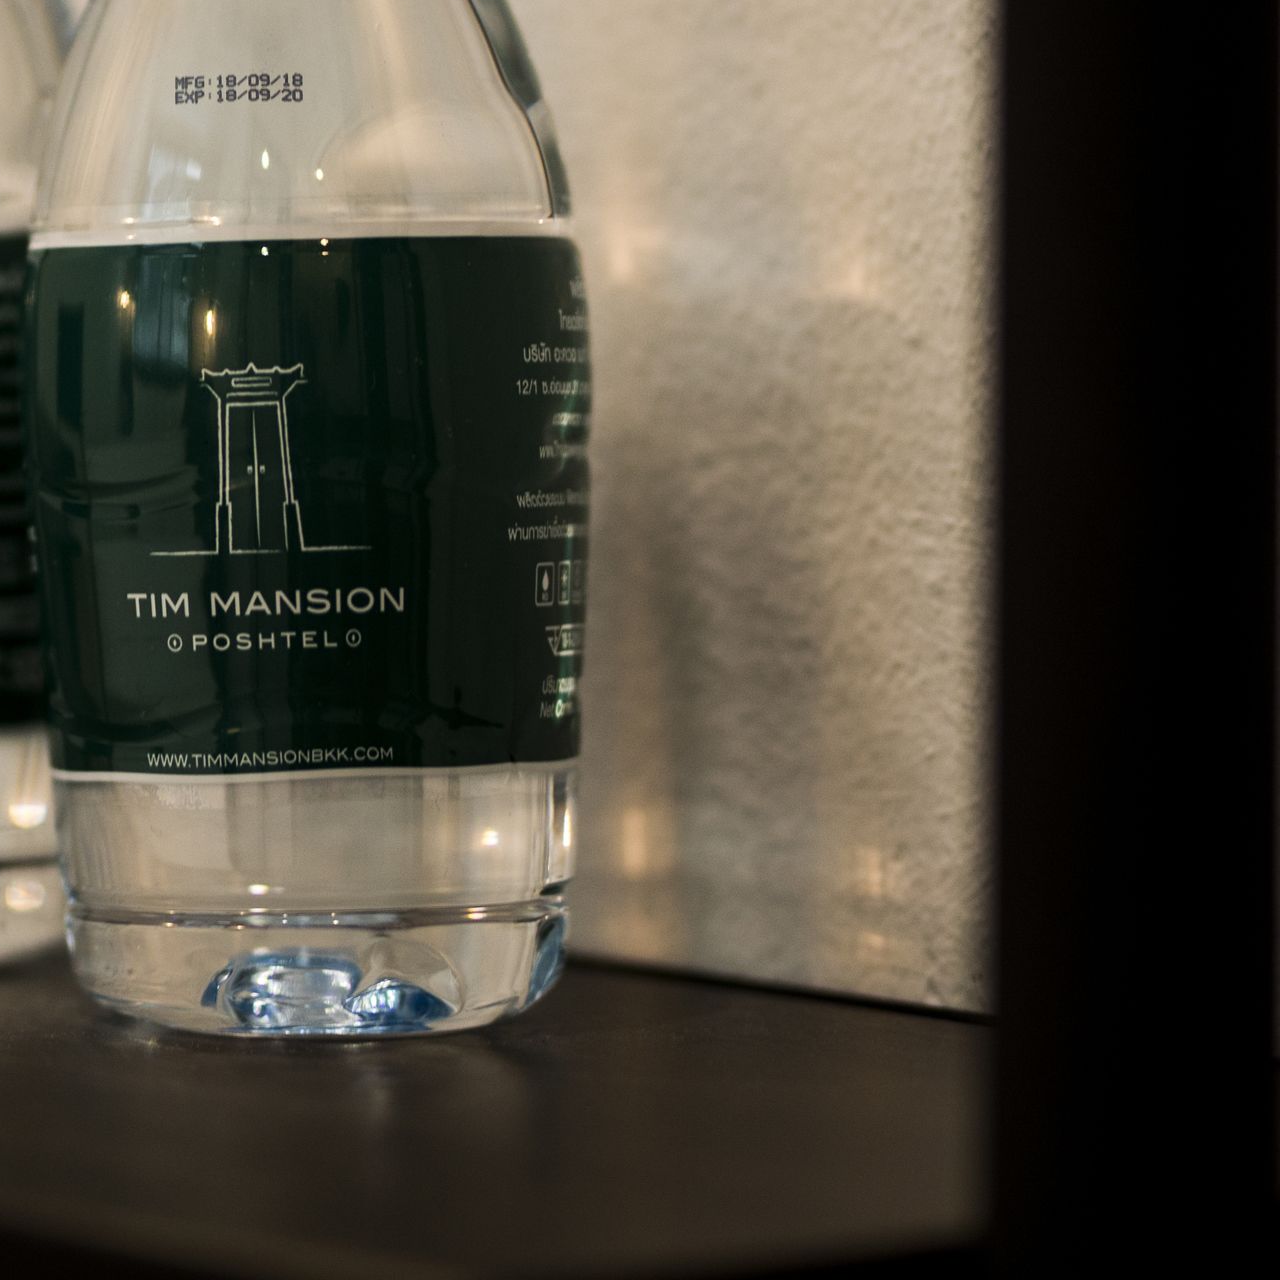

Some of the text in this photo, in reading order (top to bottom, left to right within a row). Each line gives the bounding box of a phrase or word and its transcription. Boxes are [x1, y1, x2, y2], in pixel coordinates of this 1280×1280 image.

[523, 341, 552, 364] บริษัท
[515, 379, 538, 396] 12/1
[126, 587, 405, 618] TIM MANSION
[192, 631, 337, 652] POSHTEL
[146, 747, 394, 769] WWW.TIMMANSIONBKK.COM
